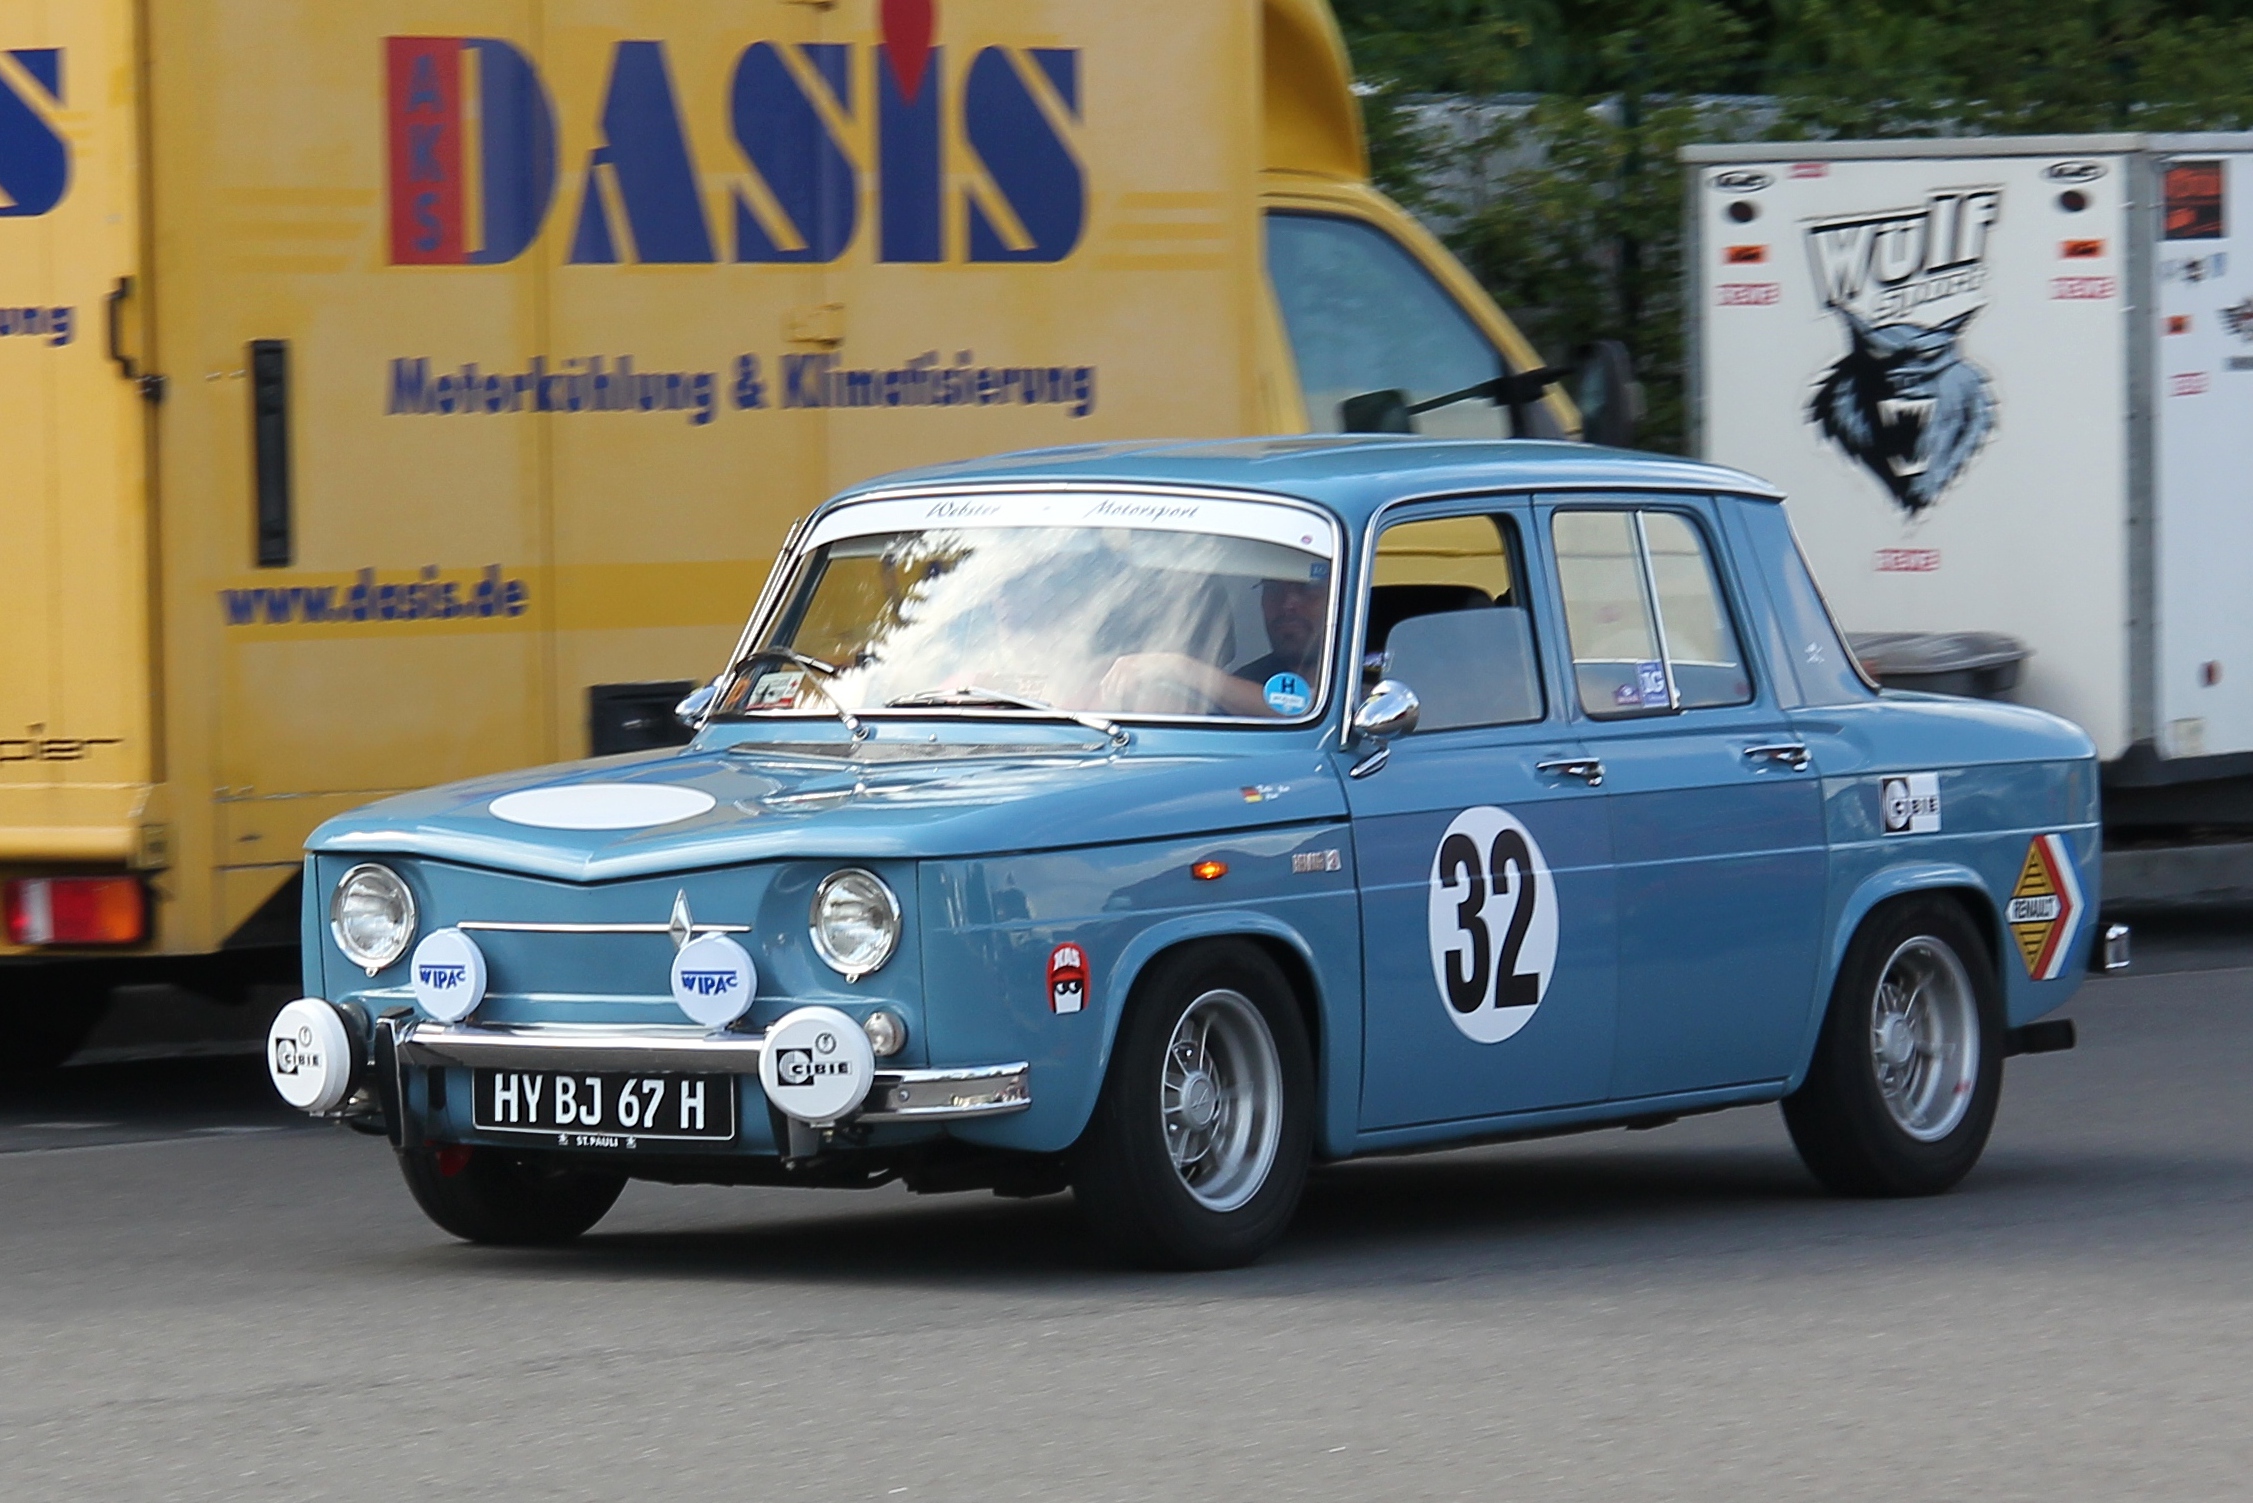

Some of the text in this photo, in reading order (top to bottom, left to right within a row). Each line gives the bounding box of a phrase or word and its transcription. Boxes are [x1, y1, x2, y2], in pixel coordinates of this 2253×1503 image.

[404, 54, 446, 251] AKS
[386, 350, 1097, 426] Motorkühlung & Klimatisierung
[926, 501, 1000, 519] Webster
[1083, 499, 1199, 522] Motorsport
[218, 563, 529, 626] www.dasis.de
[1280, 677, 1295, 695] H
[2013, 897, 2053, 920] RENAULT
[1440, 828, 1540, 1014] 32
[420, 969, 466, 990] WIPAC
[682, 975, 738, 995] WIPAC
[284, 1053, 319, 1067] CIBIE
[791, 1062, 849, 1075] CIBIE
[494, 1073, 705, 1130] HY BJ 67 H
